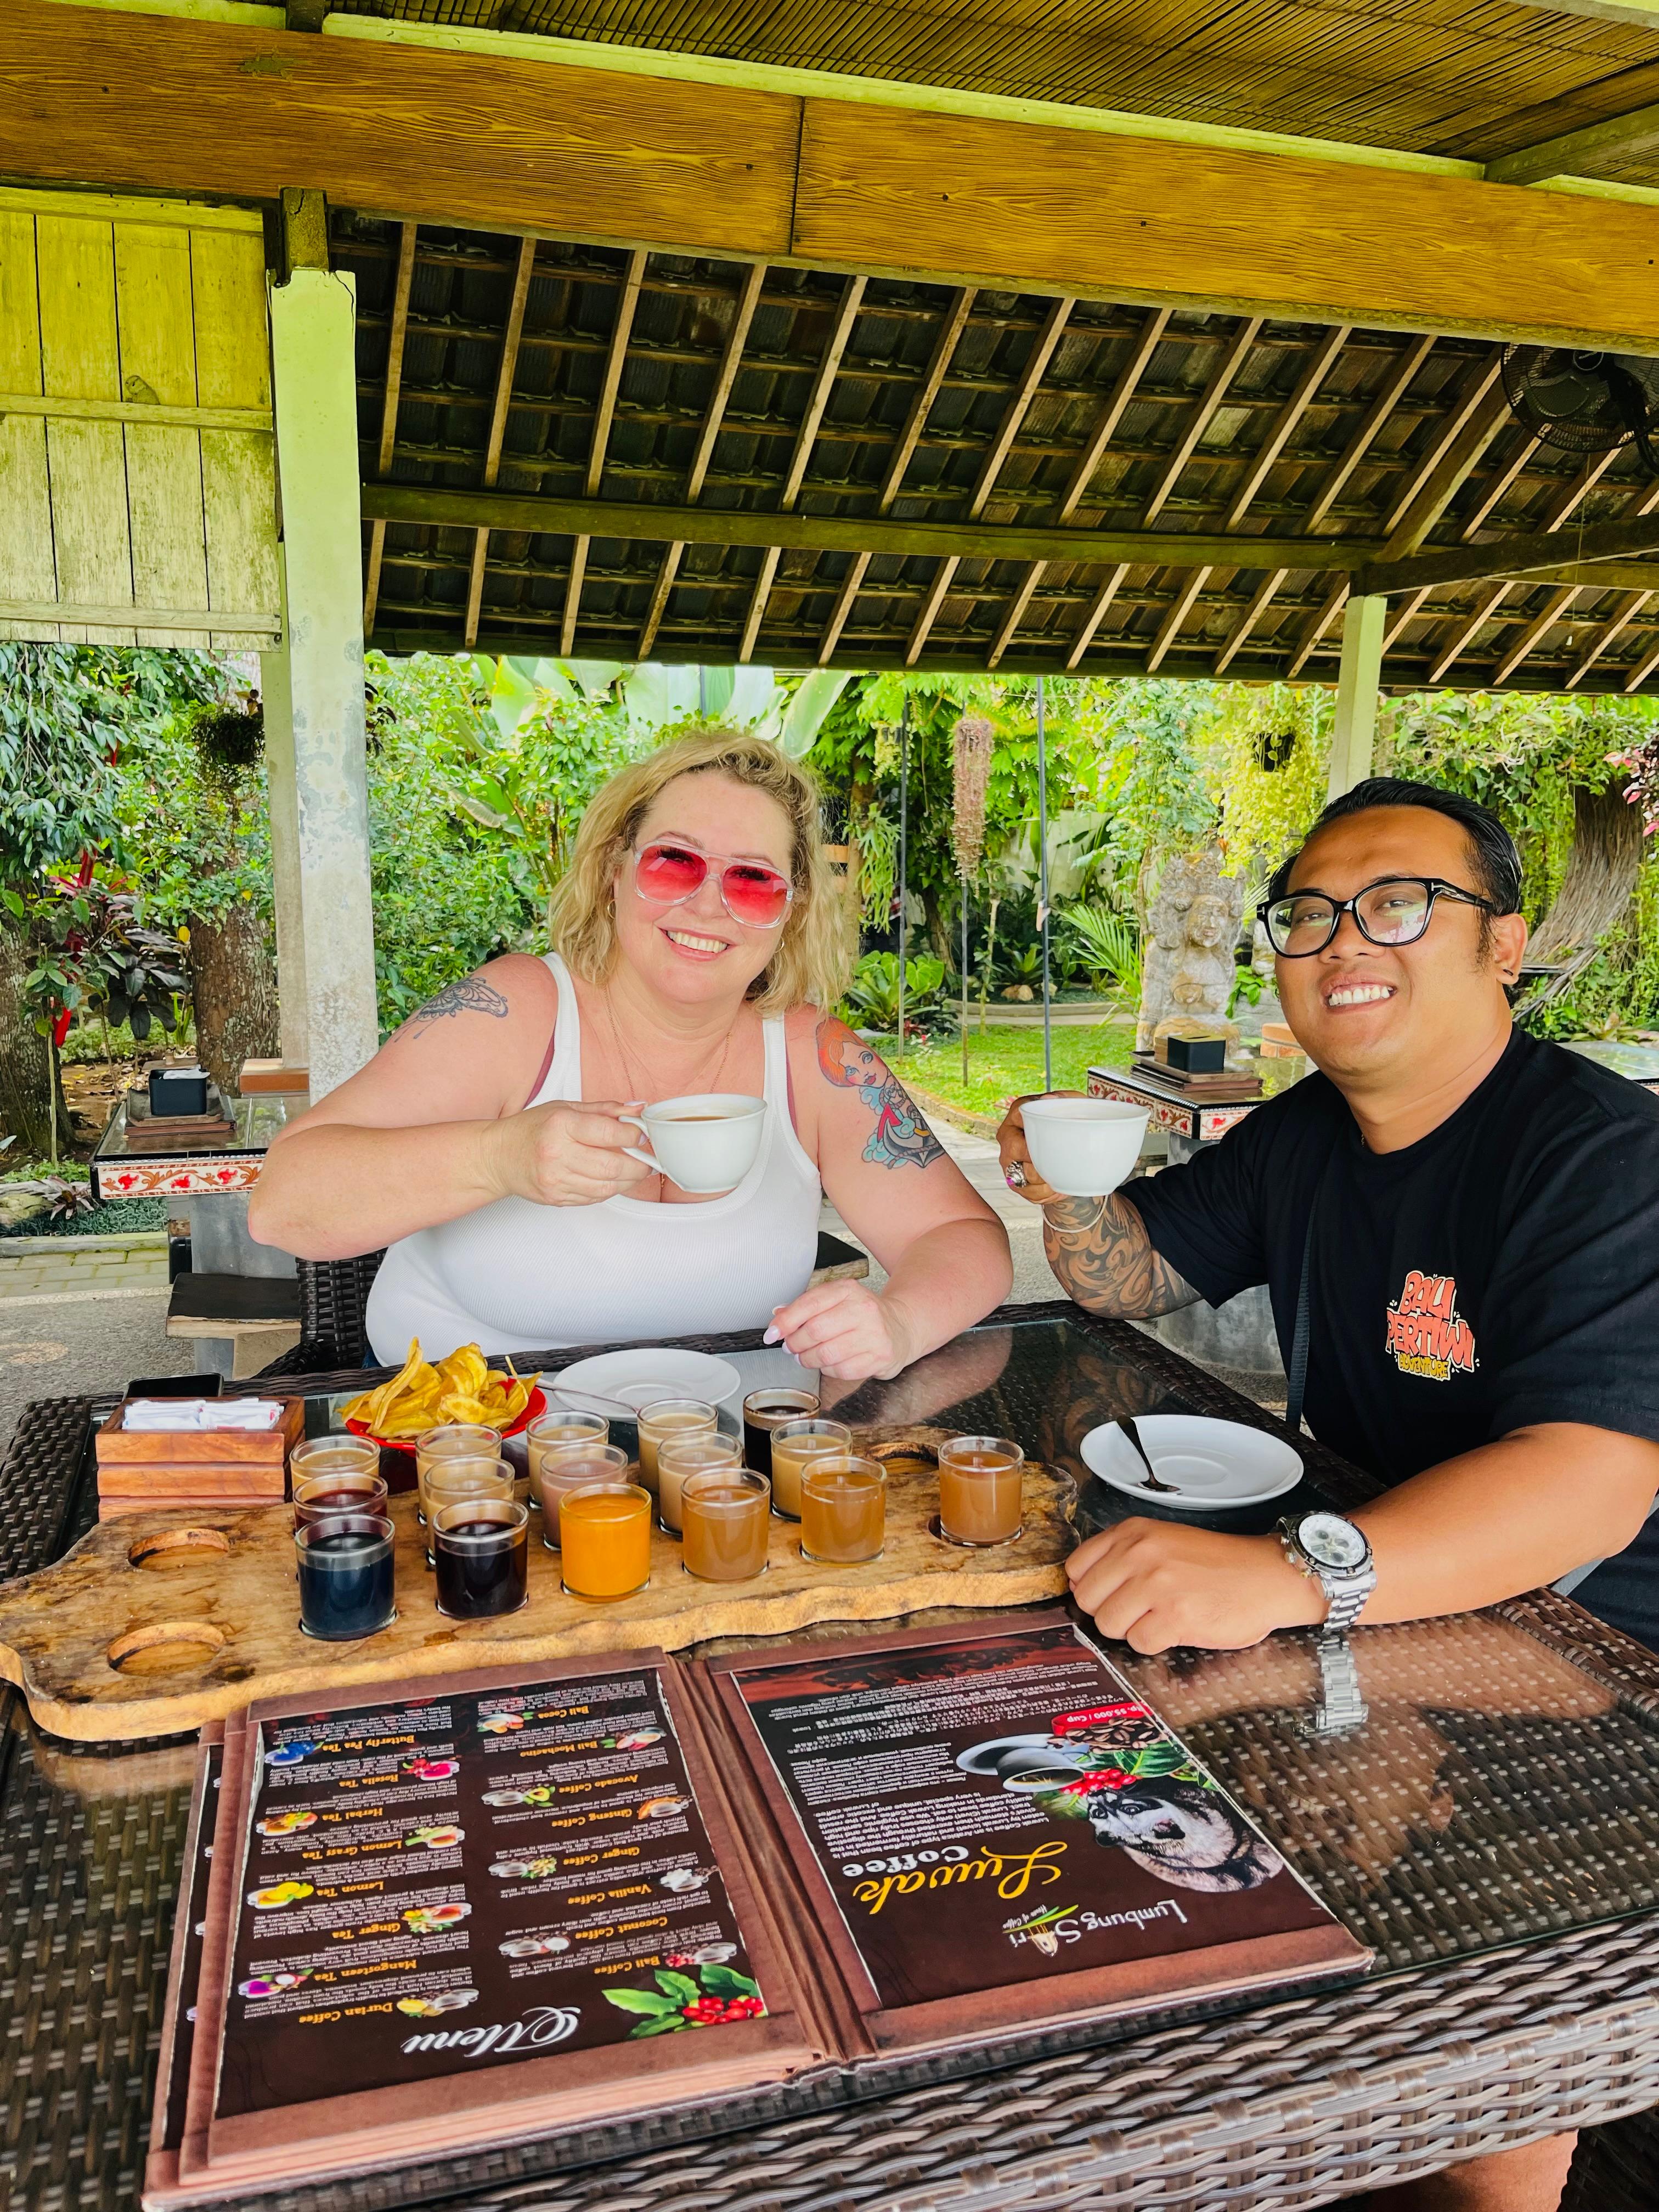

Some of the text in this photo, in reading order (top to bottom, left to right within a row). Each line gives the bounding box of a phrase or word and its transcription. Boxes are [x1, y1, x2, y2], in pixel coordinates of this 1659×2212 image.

[1400, 1271, 1457, 1321] BALI
[1398, 1352, 1450, 1380] ADVENTURE
[537, 1705, 589, 1719] Bali Cocoa
[322, 1734, 414, 1752] Butterfly Pea Tea
[520, 1740, 598, 1758] Bali Mochacino
[338, 1774, 398, 1788] Rosella Tea
[558, 1774, 638, 1794] Avocado Coffee
[321, 1807, 383, 1822] Herbal Tea
[551, 1808, 633, 1828] Ginseng Coffee
[302, 1840, 402, 1860] Lemon Grass Tea
[563, 1846, 640, 1866] Ginger Coffee
[842, 1846, 969, 1877] Coffee
[853, 1841, 1068, 1915] Luwak
[316, 1881, 383, 1897] Lemon Tea
[567, 1883, 652, 1905] Vanilla Coffee
[1002, 1918, 1022, 1929] Coffee
[1081, 1900, 1187, 1931] Lumbung
[331, 1922, 400, 1940] Ginger Tea
[574, 1916, 668, 1940] Coconut Coffee
[314, 1959, 417, 1983] Mangosteen Tea
[594, 1955, 661, 1975] Bali Coffee
[298, 2002, 393, 2024] Durian Coffee
[400, 2006, 581, 2057] Menu
